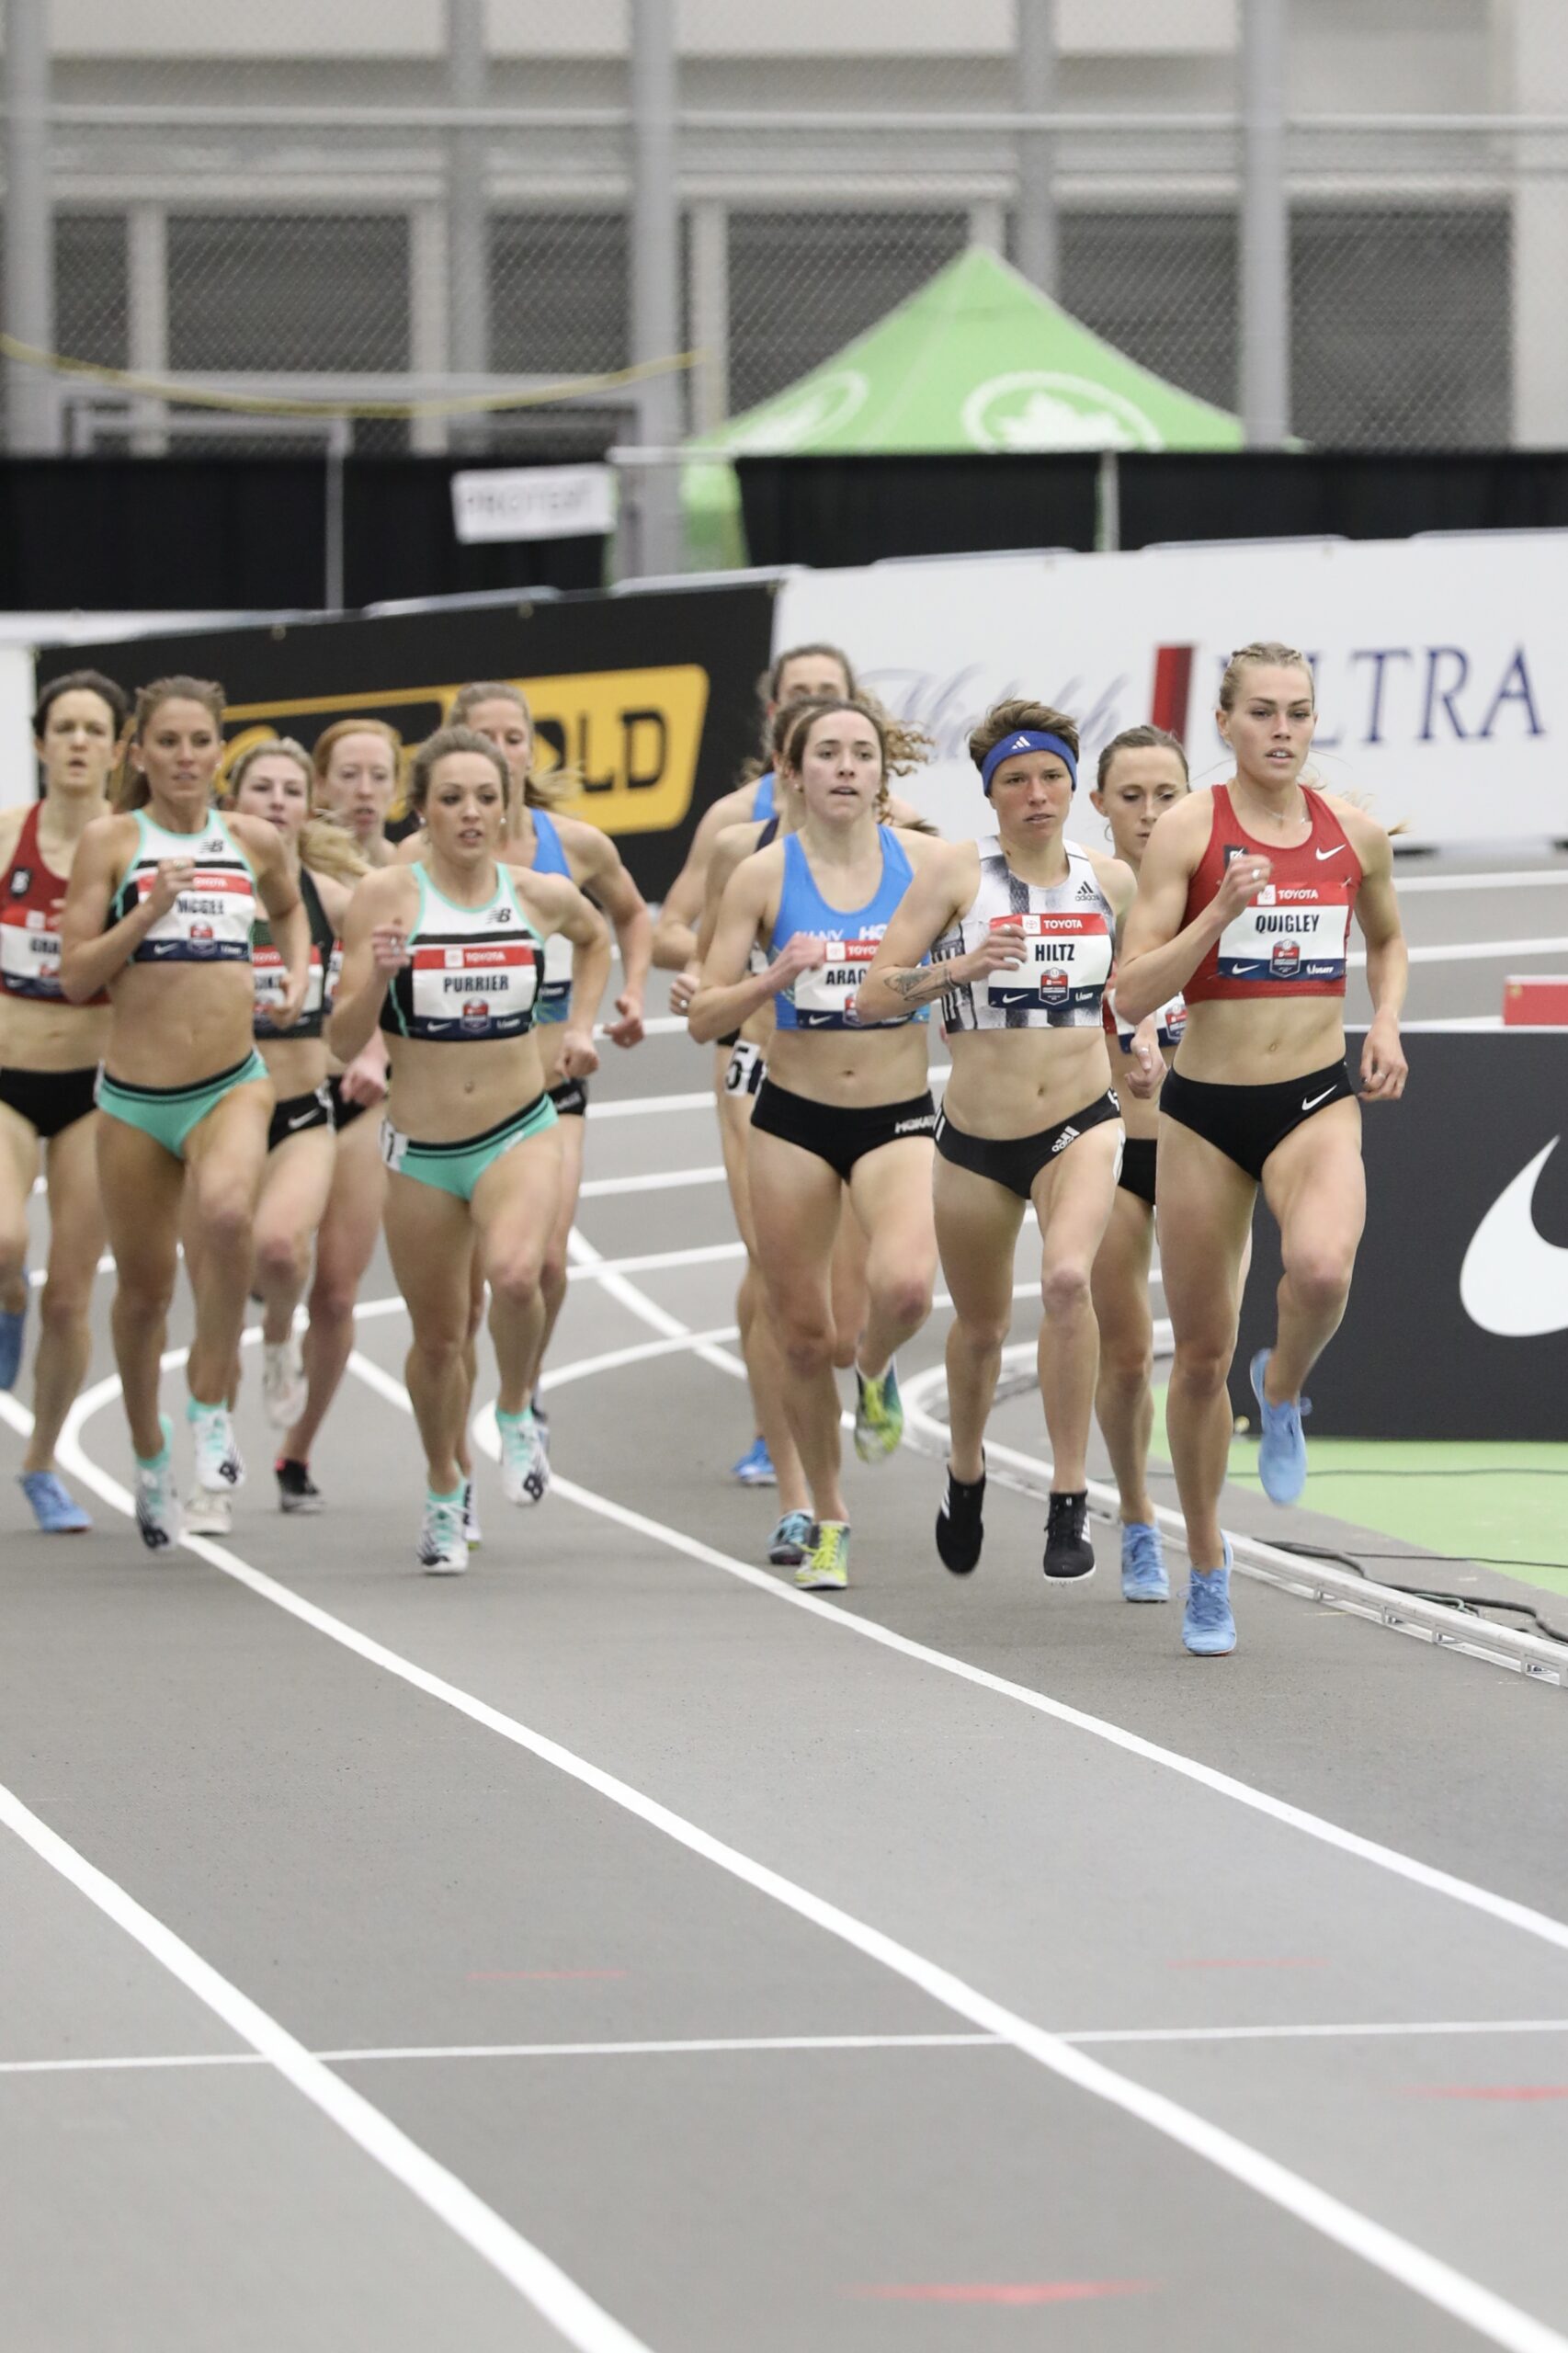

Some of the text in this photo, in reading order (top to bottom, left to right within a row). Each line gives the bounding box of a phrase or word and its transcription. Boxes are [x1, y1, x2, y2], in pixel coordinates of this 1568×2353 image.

[1278, 889, 1318, 900] TOYOTA
[1044, 919, 1083, 929] TOYOTA
[1255, 914, 1319, 933] QUIGLEY
[466, 950, 506, 962] TOYOTA
[847, 944, 877, 956] TOYO
[1035, 944, 1074, 961] HILTZ
[444, 974, 509, 993] PURRIER
